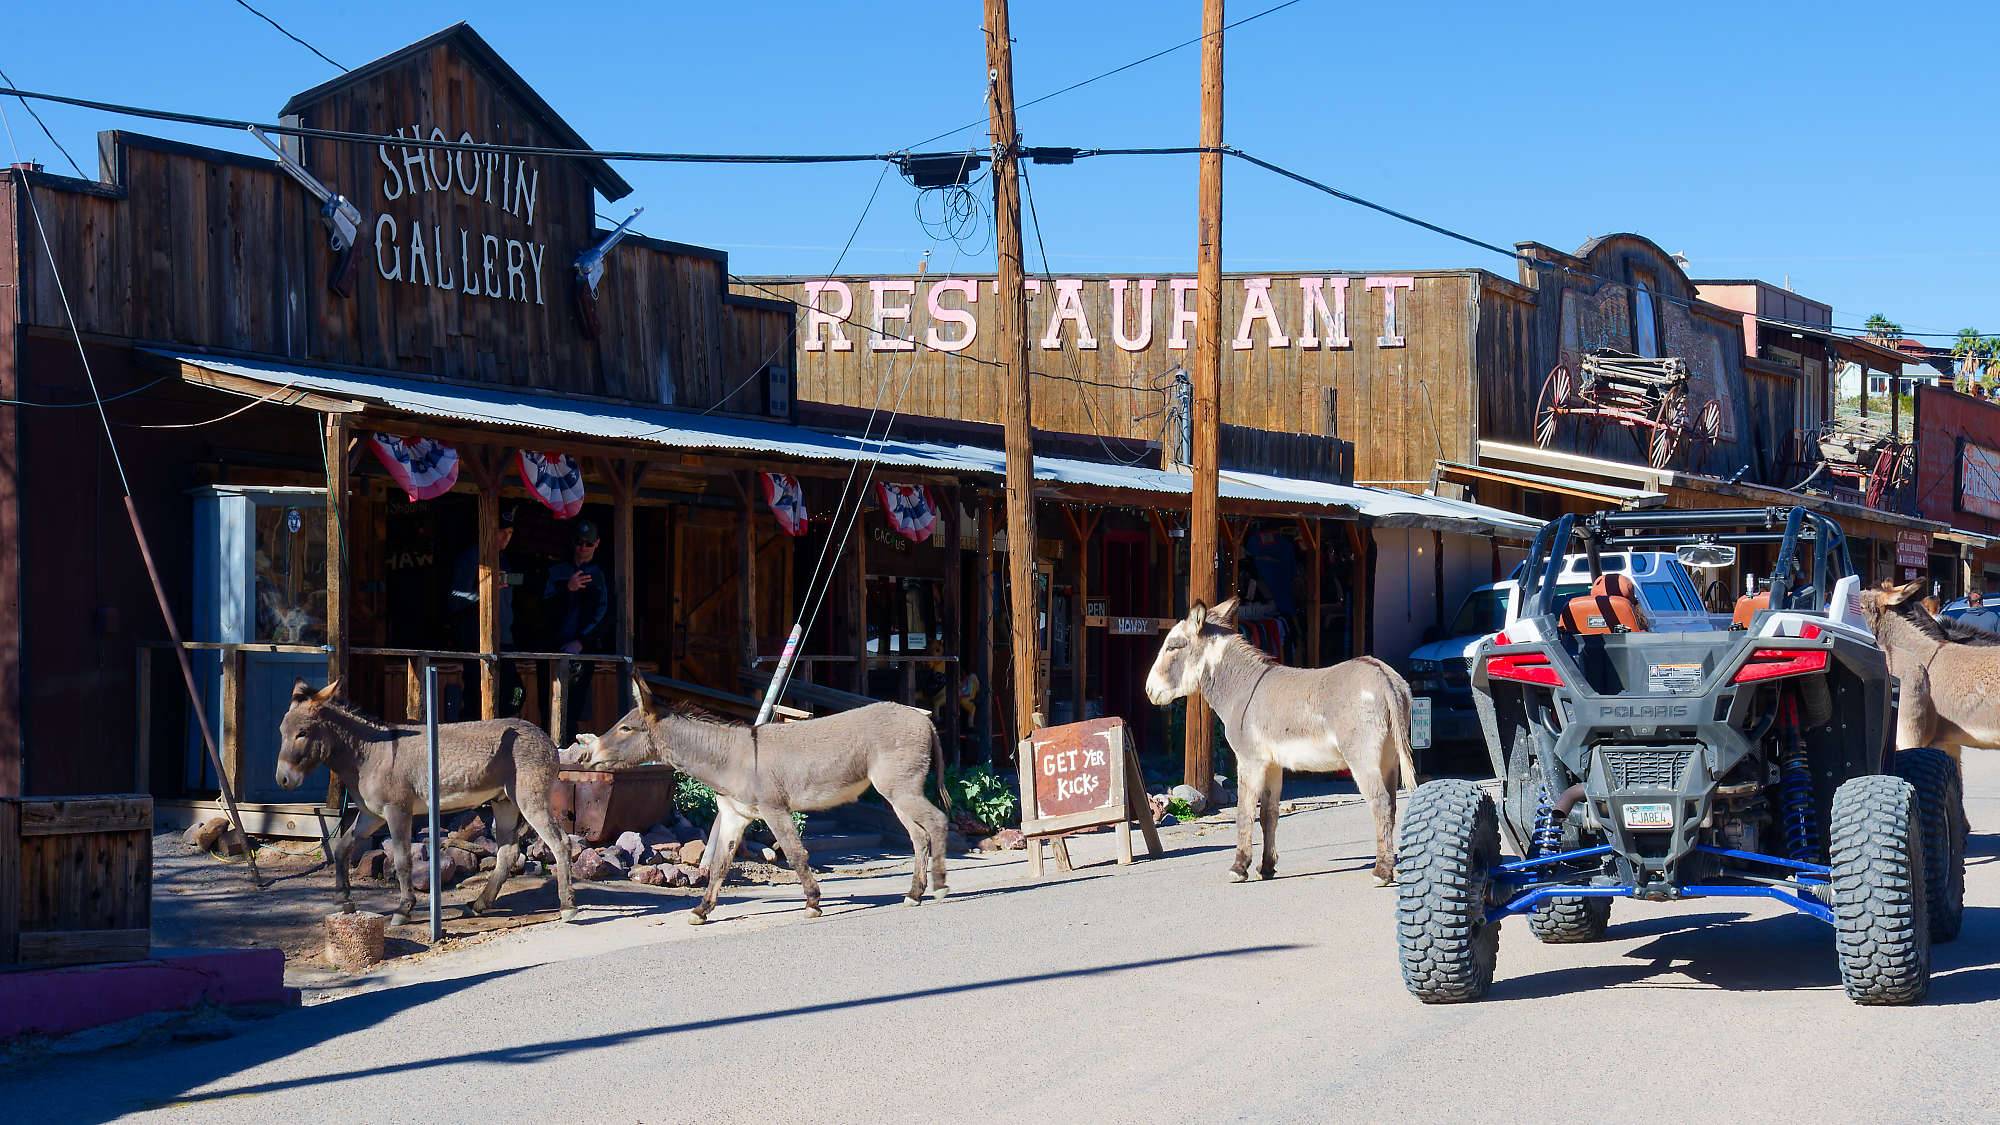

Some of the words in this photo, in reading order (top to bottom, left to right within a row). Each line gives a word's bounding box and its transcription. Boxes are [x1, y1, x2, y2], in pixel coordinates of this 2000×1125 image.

[374, 213, 545, 305] GALLERY
[1087, 602, 1105, 616] PEN
[1118, 618, 1148, 633] HOWDY
[1600, 705, 1688, 718] POLARIS
[1043, 749, 1077, 776] GET
[1083, 749, 1106, 768] YER
[1057, 773, 1099, 801] KICKS
